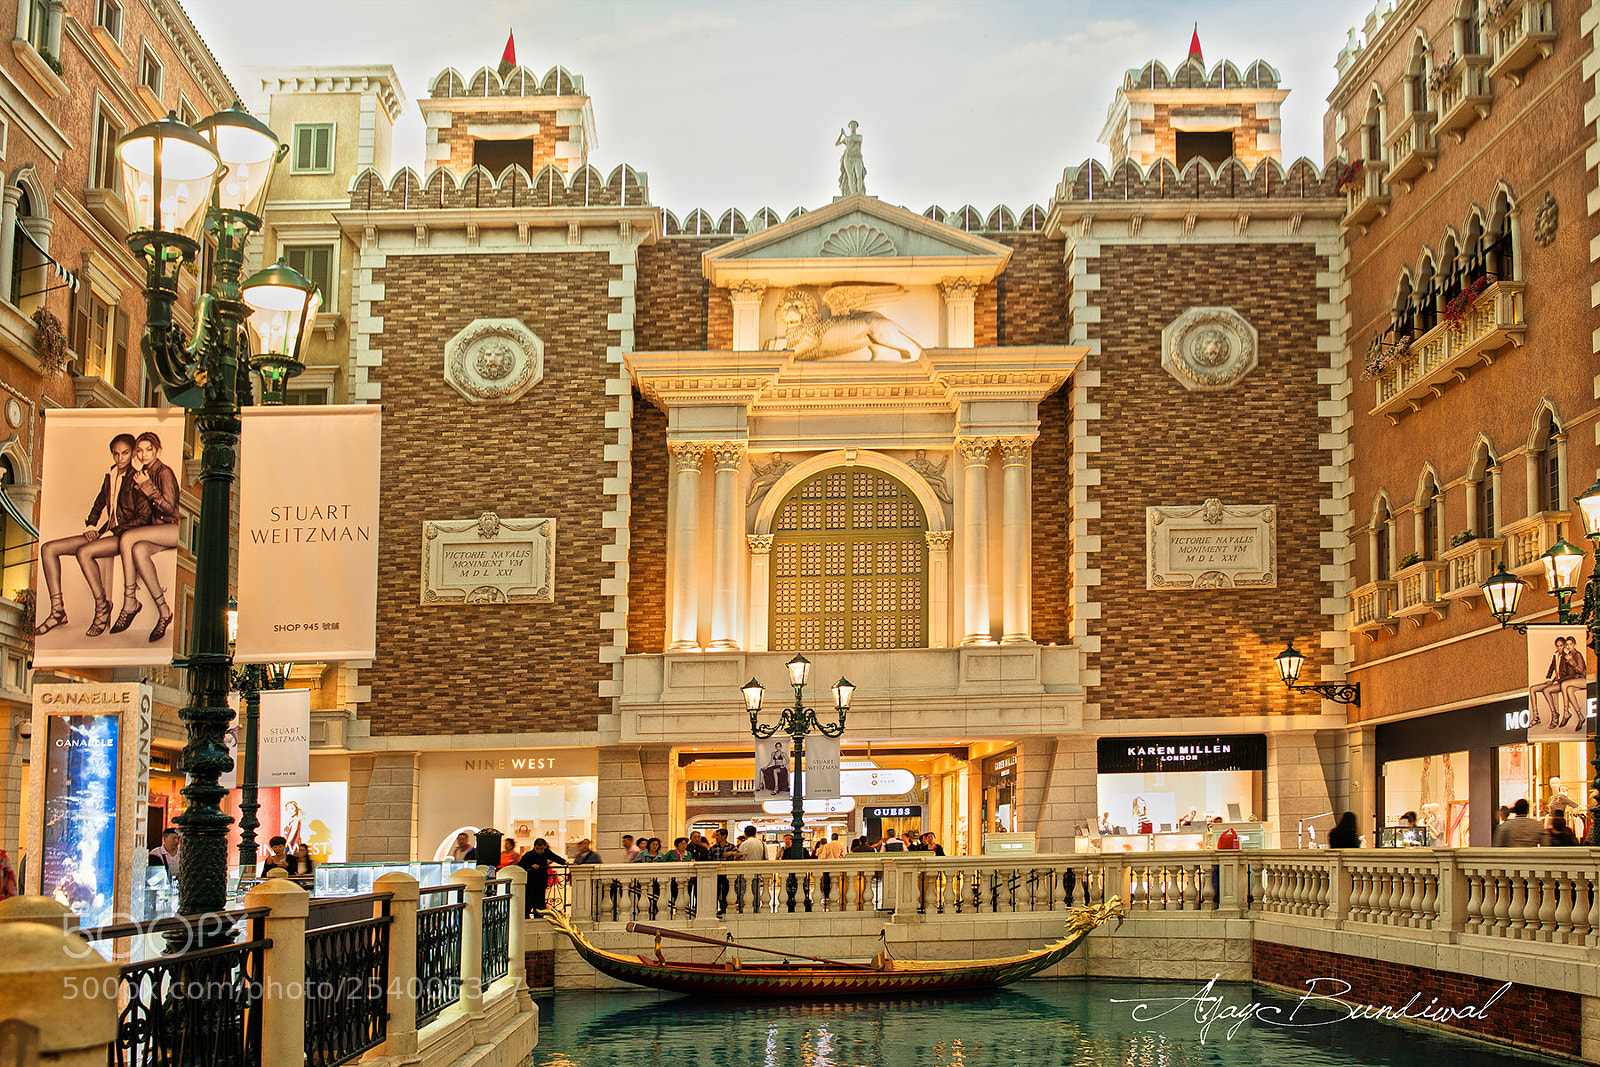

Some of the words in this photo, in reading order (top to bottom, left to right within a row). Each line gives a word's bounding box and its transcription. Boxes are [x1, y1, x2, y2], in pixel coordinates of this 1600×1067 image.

[270, 504, 352, 522] STUART
[250, 525, 370, 544] WEITZMAN
[273, 623, 301, 632] SHOP
[303, 623, 319, 631] 945
[40, 691, 131, 704] GANAELLE
[269, 727, 299, 735] STUART
[55, 738, 114, 748] GANAELLE
[263, 735, 307, 744] WEITZMAN
[1127, 746, 1175, 756] KAREN
[1179, 744, 1231, 755] MILLEN
[1160, 754, 1198, 762] LONDON
[464, 759, 505, 771] NINE
[511, 757, 556, 770] WEST
[135, 694, 150, 848] GANAELLE
[873, 807, 911, 816] GUESS
